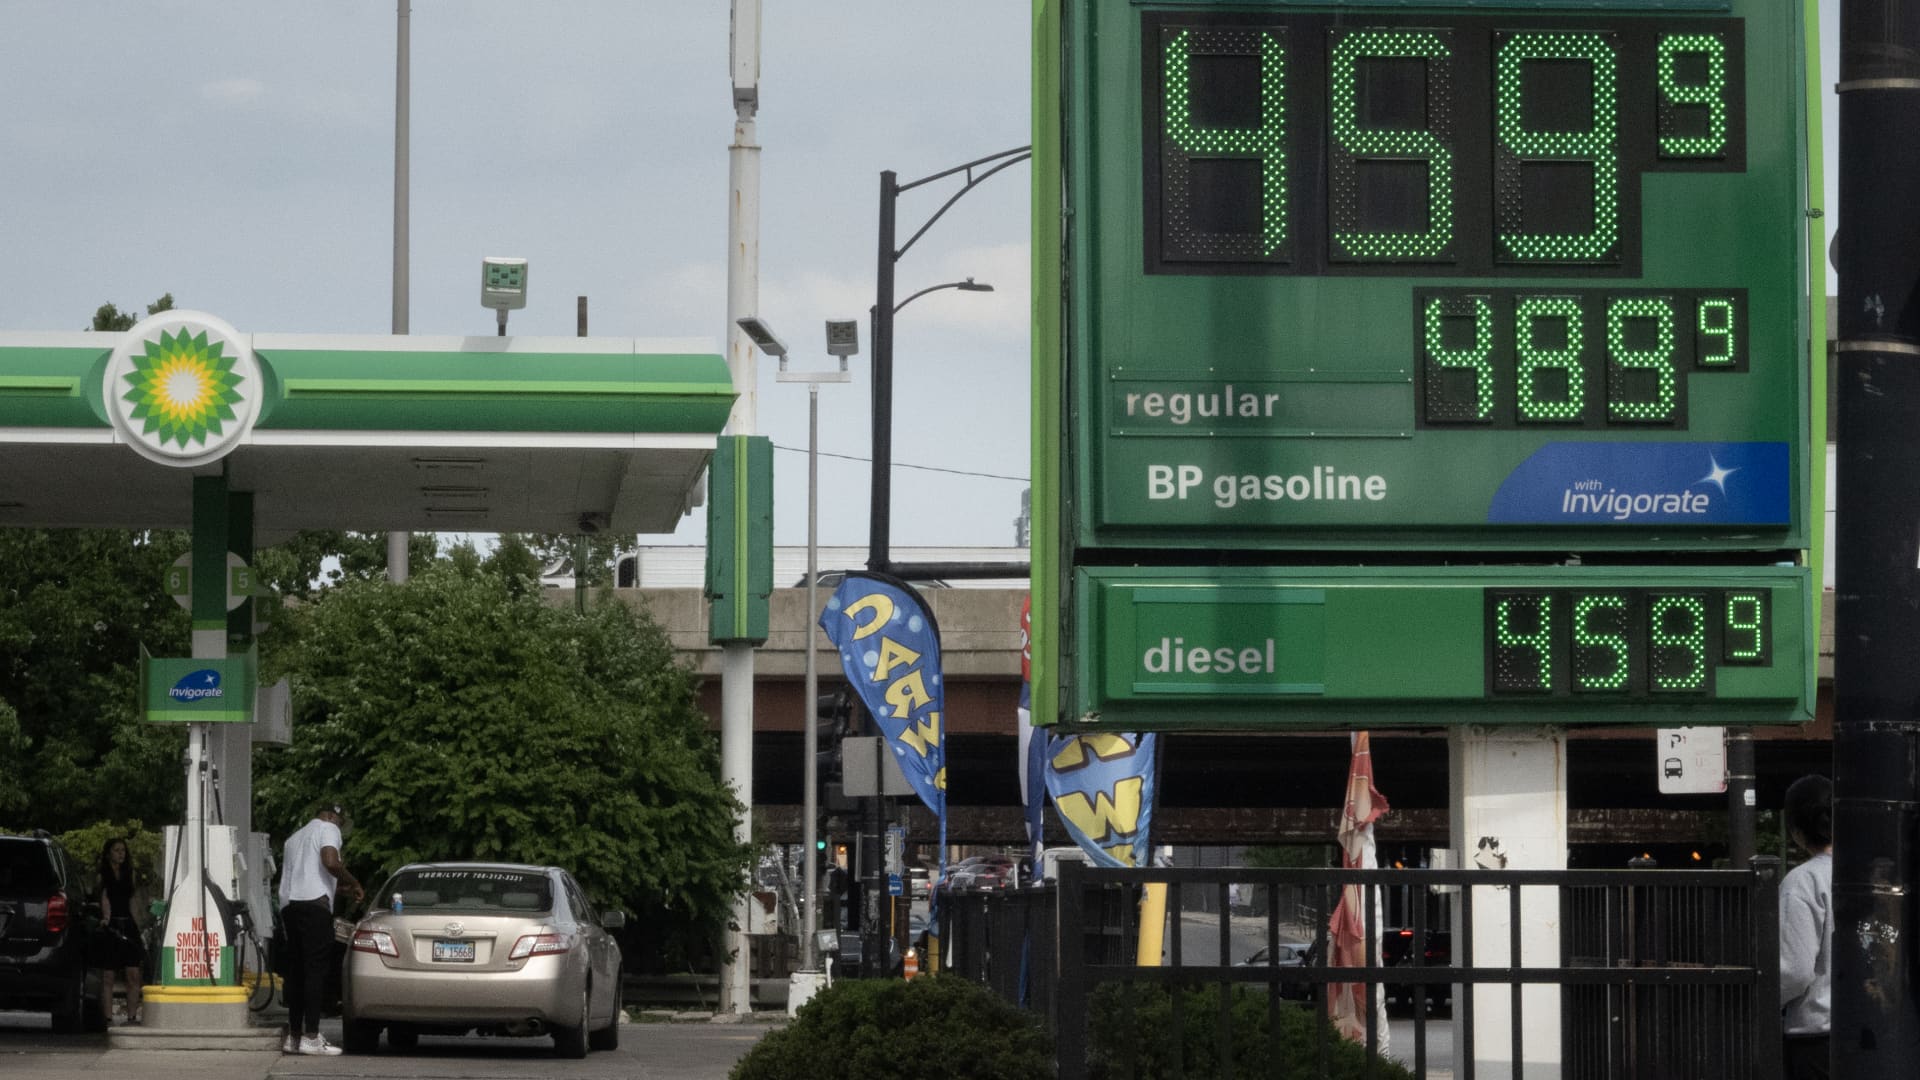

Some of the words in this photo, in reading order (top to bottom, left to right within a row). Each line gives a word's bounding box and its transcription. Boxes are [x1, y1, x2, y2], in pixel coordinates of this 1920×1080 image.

[1125, 384, 1280, 425] regular
[1147, 465, 1204, 500] BP
[1212, 465, 1388, 509] gasoline
[1573, 477, 1603, 492] with
[1561, 487, 1711, 520] Invigorate
[170, 572, 180, 589] 6
[238, 572, 249, 589] 5
[1143, 637, 1277, 675] diesel
[169, 687, 223, 700] Invigorate
[191, 917, 207, 932] NO
[176, 932, 219, 947] SMOKNG
[176, 948, 200, 963] TURN
